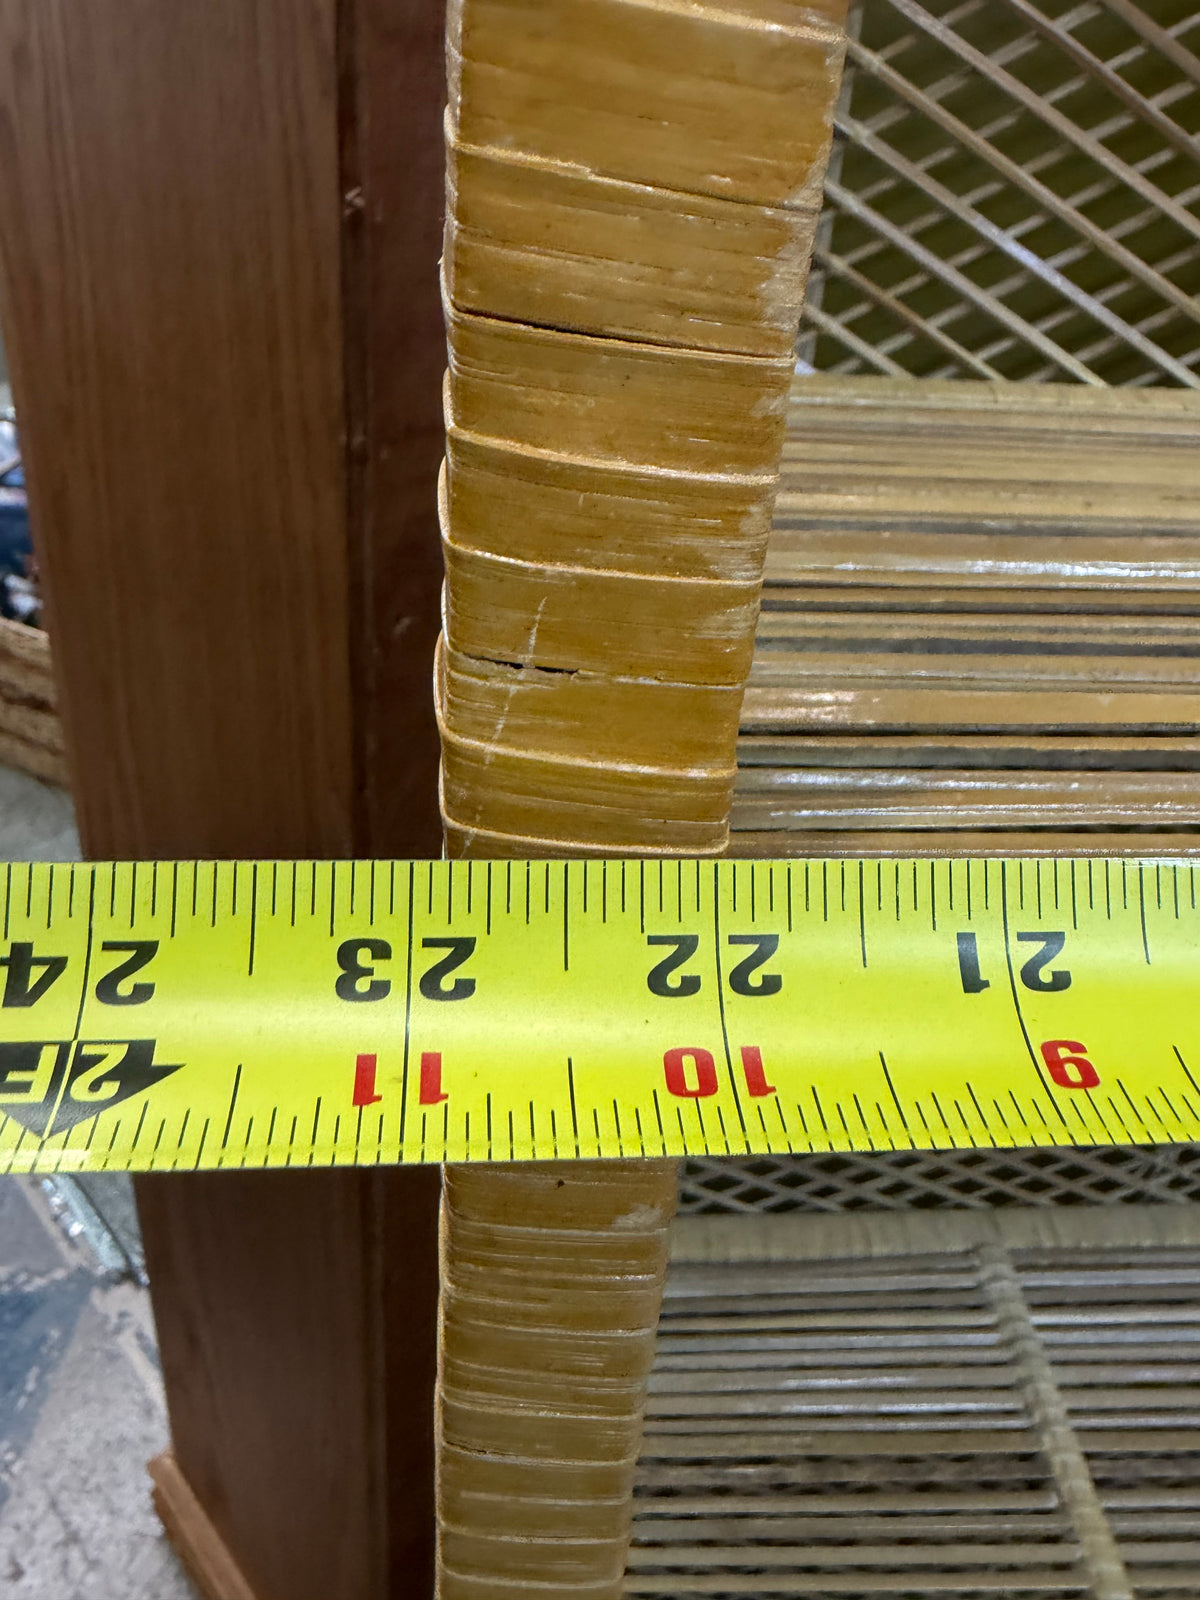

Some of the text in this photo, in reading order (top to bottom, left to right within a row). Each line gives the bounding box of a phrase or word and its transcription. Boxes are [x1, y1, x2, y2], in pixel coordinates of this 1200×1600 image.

[0, 940, 160, 1008] 24
[335, 936, 478, 1003] 23
[647, 933, 783, 998] 22
[955, 931, 1072, 994] 21
[352, 1051, 450, 1108] 11
[662, 1045, 778, 1099] 10
[1040, 1040, 1102, 1090] 9
